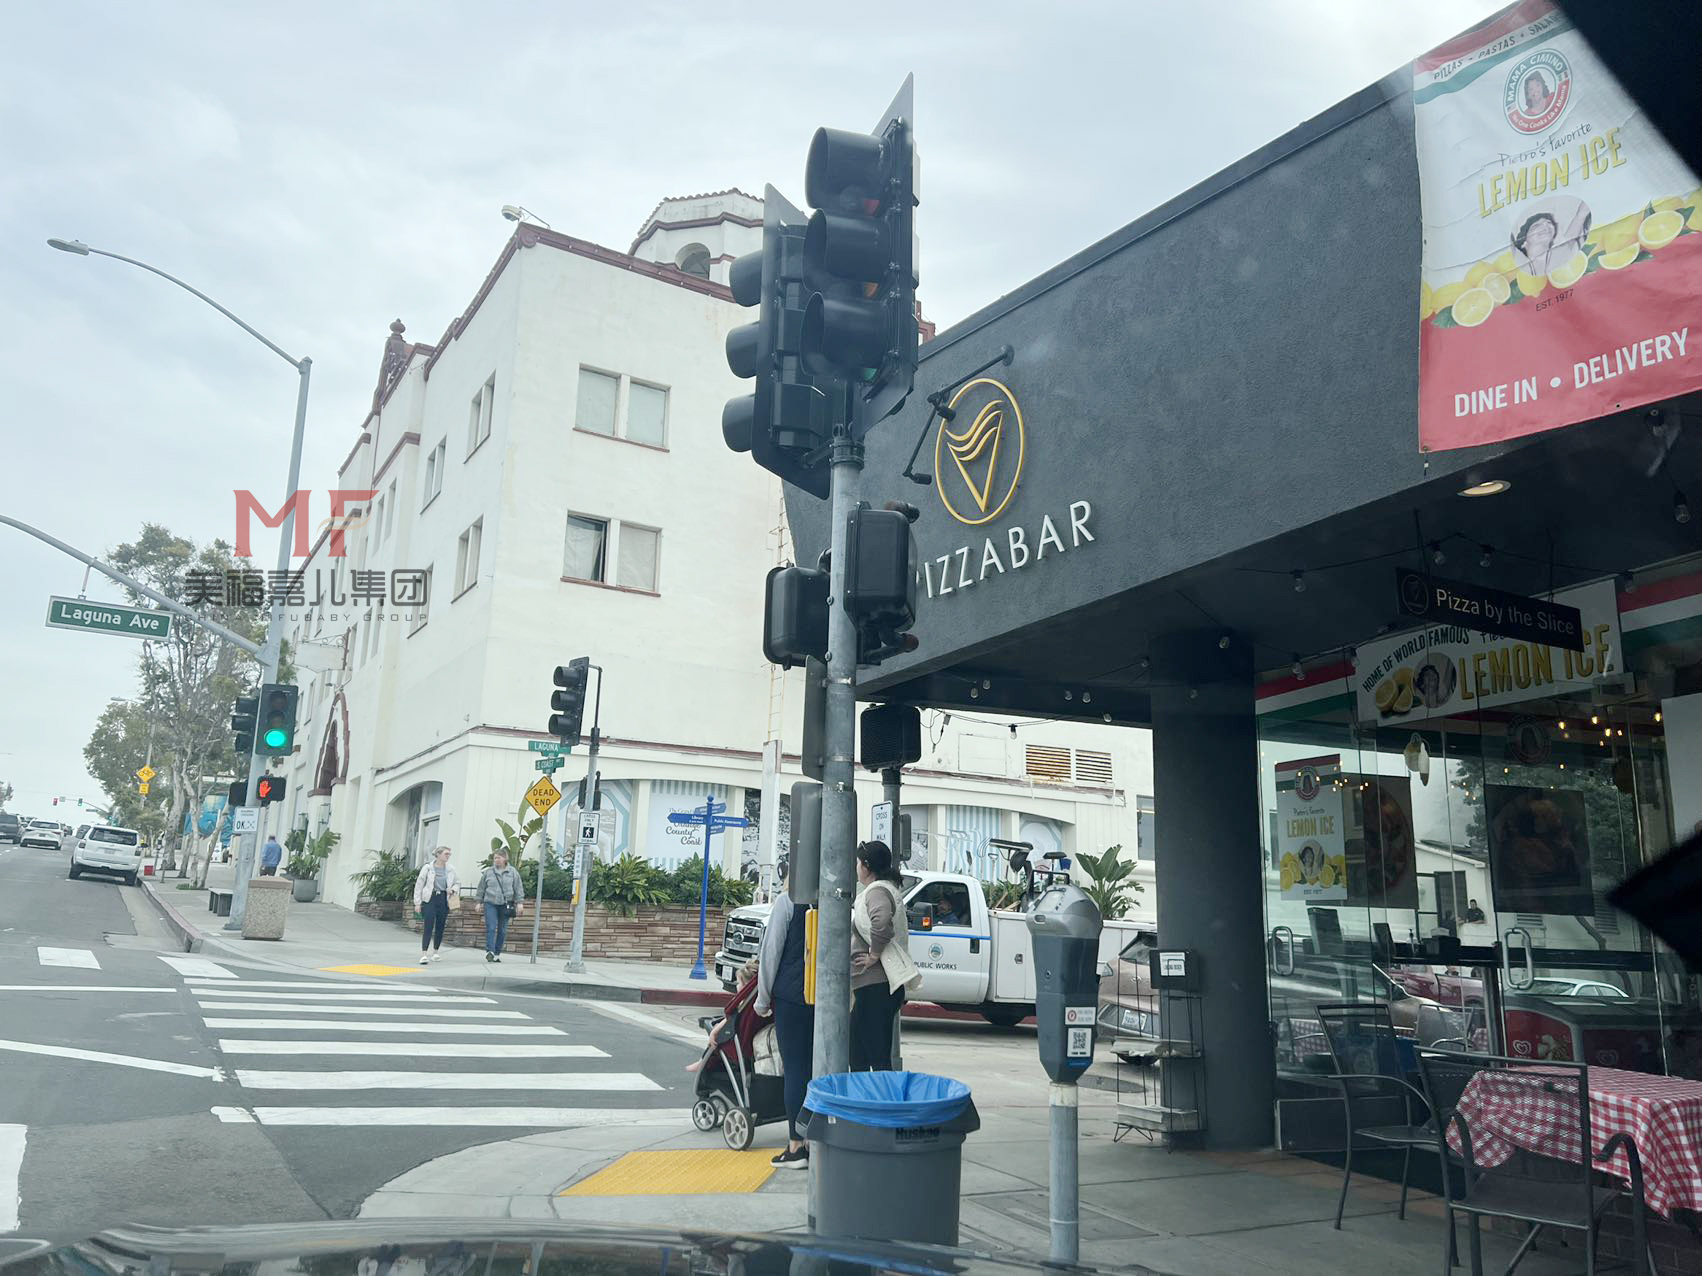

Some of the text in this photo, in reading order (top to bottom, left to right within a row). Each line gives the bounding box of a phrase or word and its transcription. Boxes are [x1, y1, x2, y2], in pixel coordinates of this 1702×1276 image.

[1433, 59, 1463, 80] PIZZAS
[1478, 35, 1516, 59] PASTAS
[1507, 53, 1564, 101] MAMA CIMINO
[1498, 122, 1592, 167] Pietro's Favorite
[1477, 127, 1627, 218] LEMON ICE
[1556, 288, 1575, 304] 1977
[1455, 327, 1689, 418] DINE IN DELIVERY
[915, 500, 1095, 600] IZZABAR
[60, 603, 160, 632] Laguna Ave
[1435, 588, 1575, 636] Pizza by the Slice
[1362, 668, 1385, 693] HOME
[1382, 655, 1394, 672] OF
[1392, 635, 1426, 664] WORLD
[1428, 625, 1470, 648] FAMOUS
[1458, 623, 1613, 701] LEMON ICE
[534, 742, 559, 752] LAGUNA
[532, 788, 554, 797] DEAD
[534, 798, 551, 807] END
[665, 825, 694, 836] County
[680, 836, 702, 846] Coast
[1286, 815, 1335, 838] LEMON ICE
[914, 961, 958, 970] PUBLIC WORKS
